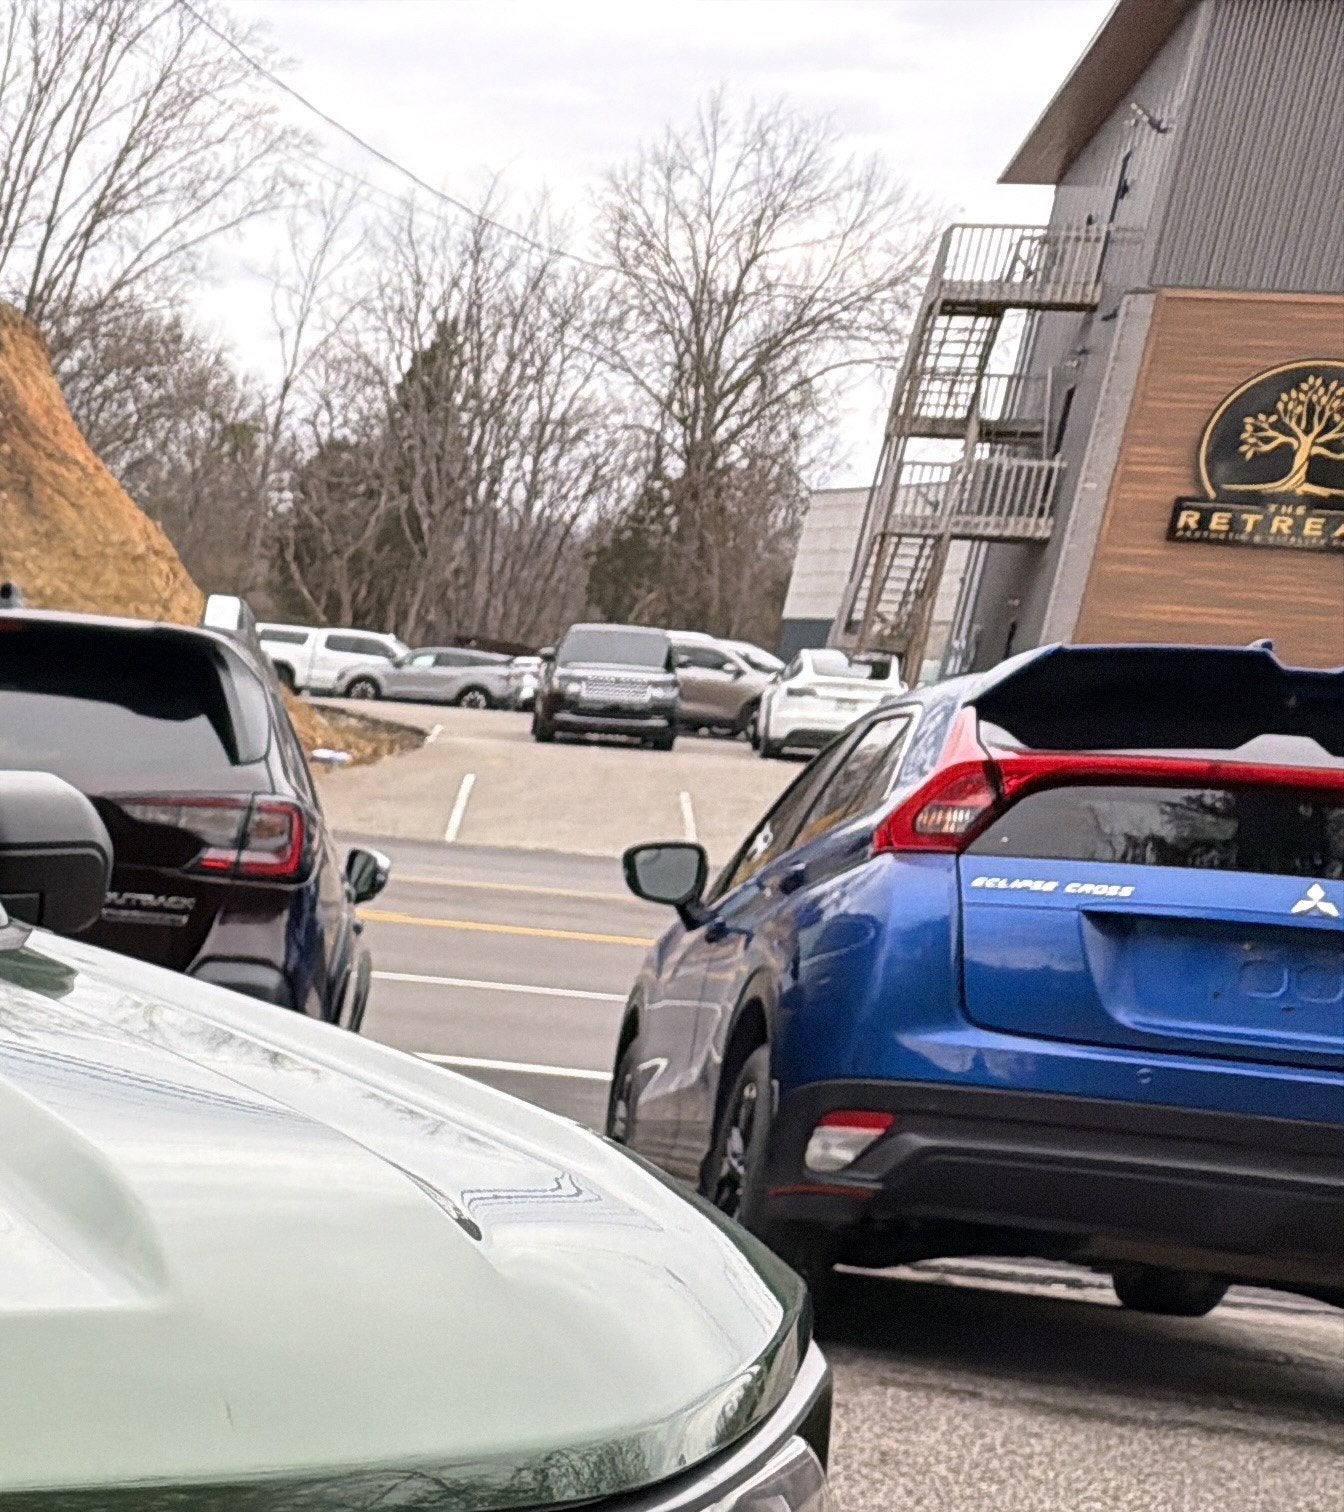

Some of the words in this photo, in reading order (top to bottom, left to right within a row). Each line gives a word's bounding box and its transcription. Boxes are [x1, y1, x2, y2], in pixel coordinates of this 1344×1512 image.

[1268, 503, 1307, 516] THE
[970, 876, 1059, 892] ECLIPSE
[1064, 882, 1135, 897] CROSS
